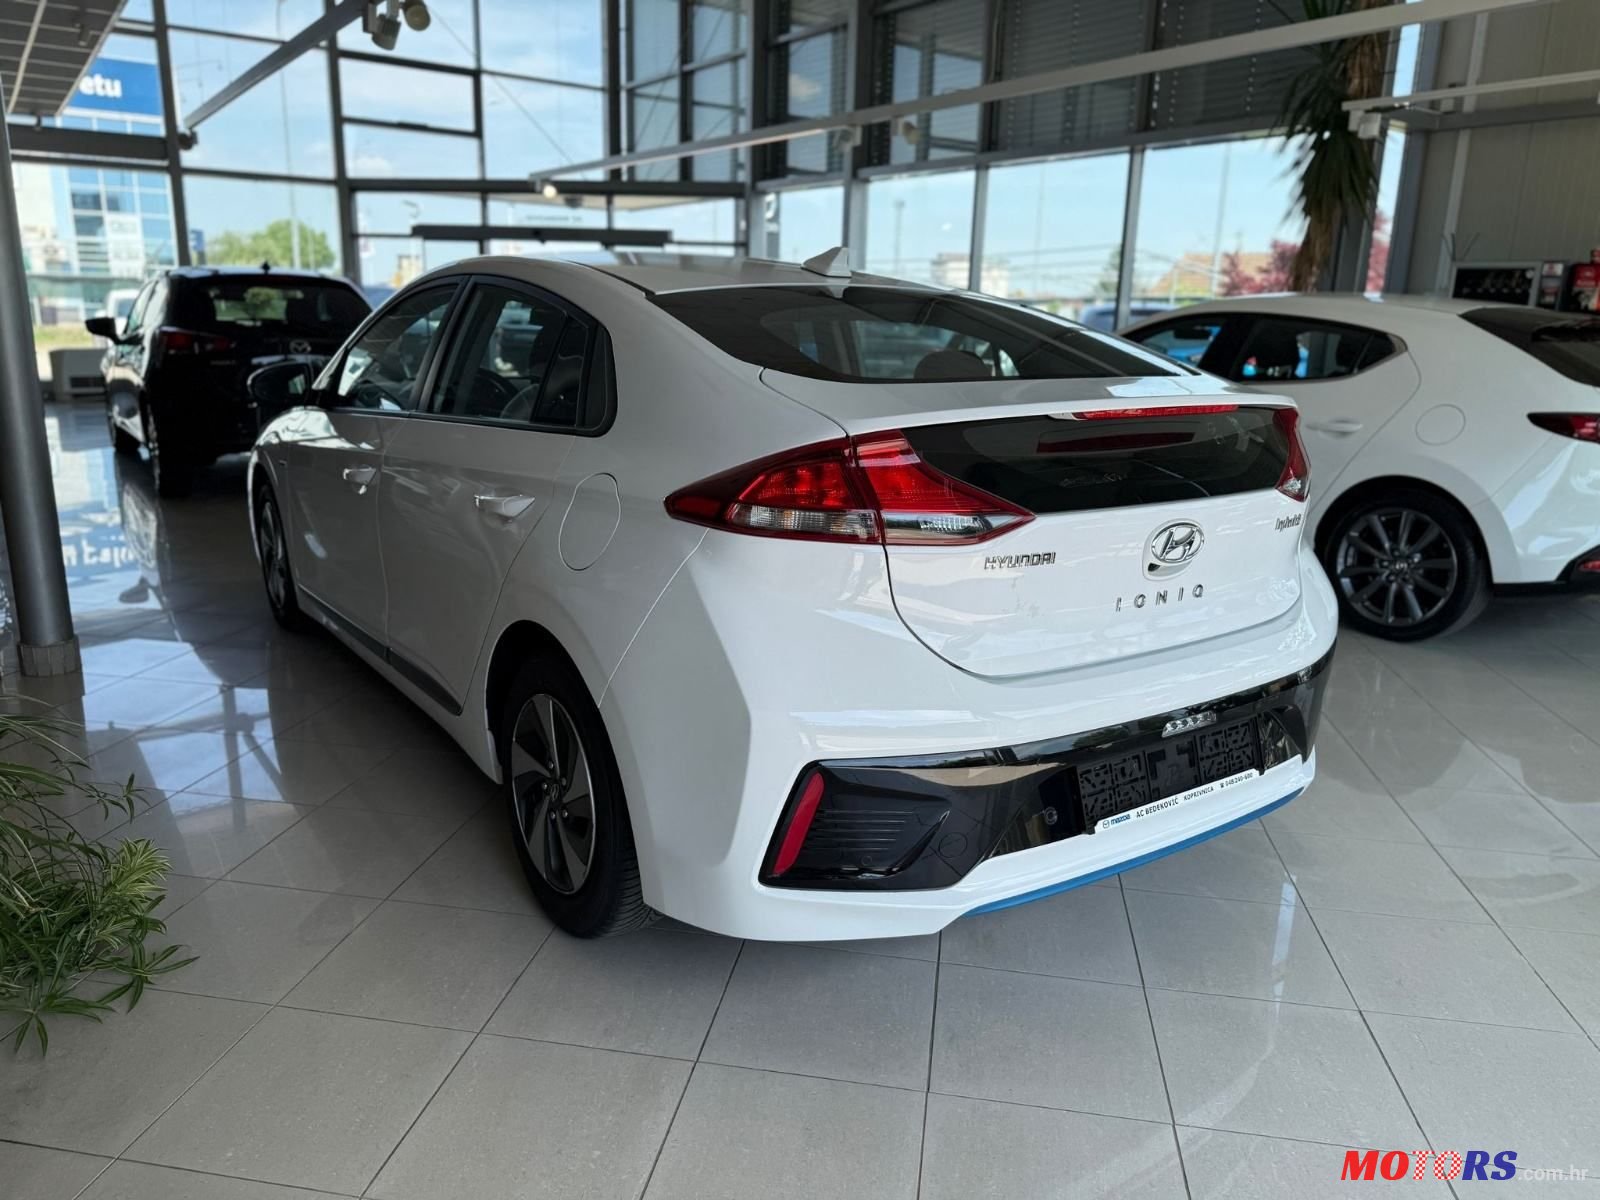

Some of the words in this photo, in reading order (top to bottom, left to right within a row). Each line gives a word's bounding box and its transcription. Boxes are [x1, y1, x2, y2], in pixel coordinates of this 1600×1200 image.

[984, 552, 1056, 569] HYUNDAI
[1115, 583, 1204, 612] IONIQ
[1110, 813, 1131, 826] mazda
[1136, 809, 1145, 818] AC
[1145, 797, 1179, 815] BEDEKOVIĆ
[1183, 786, 1214, 801] KOPRIVNICA
